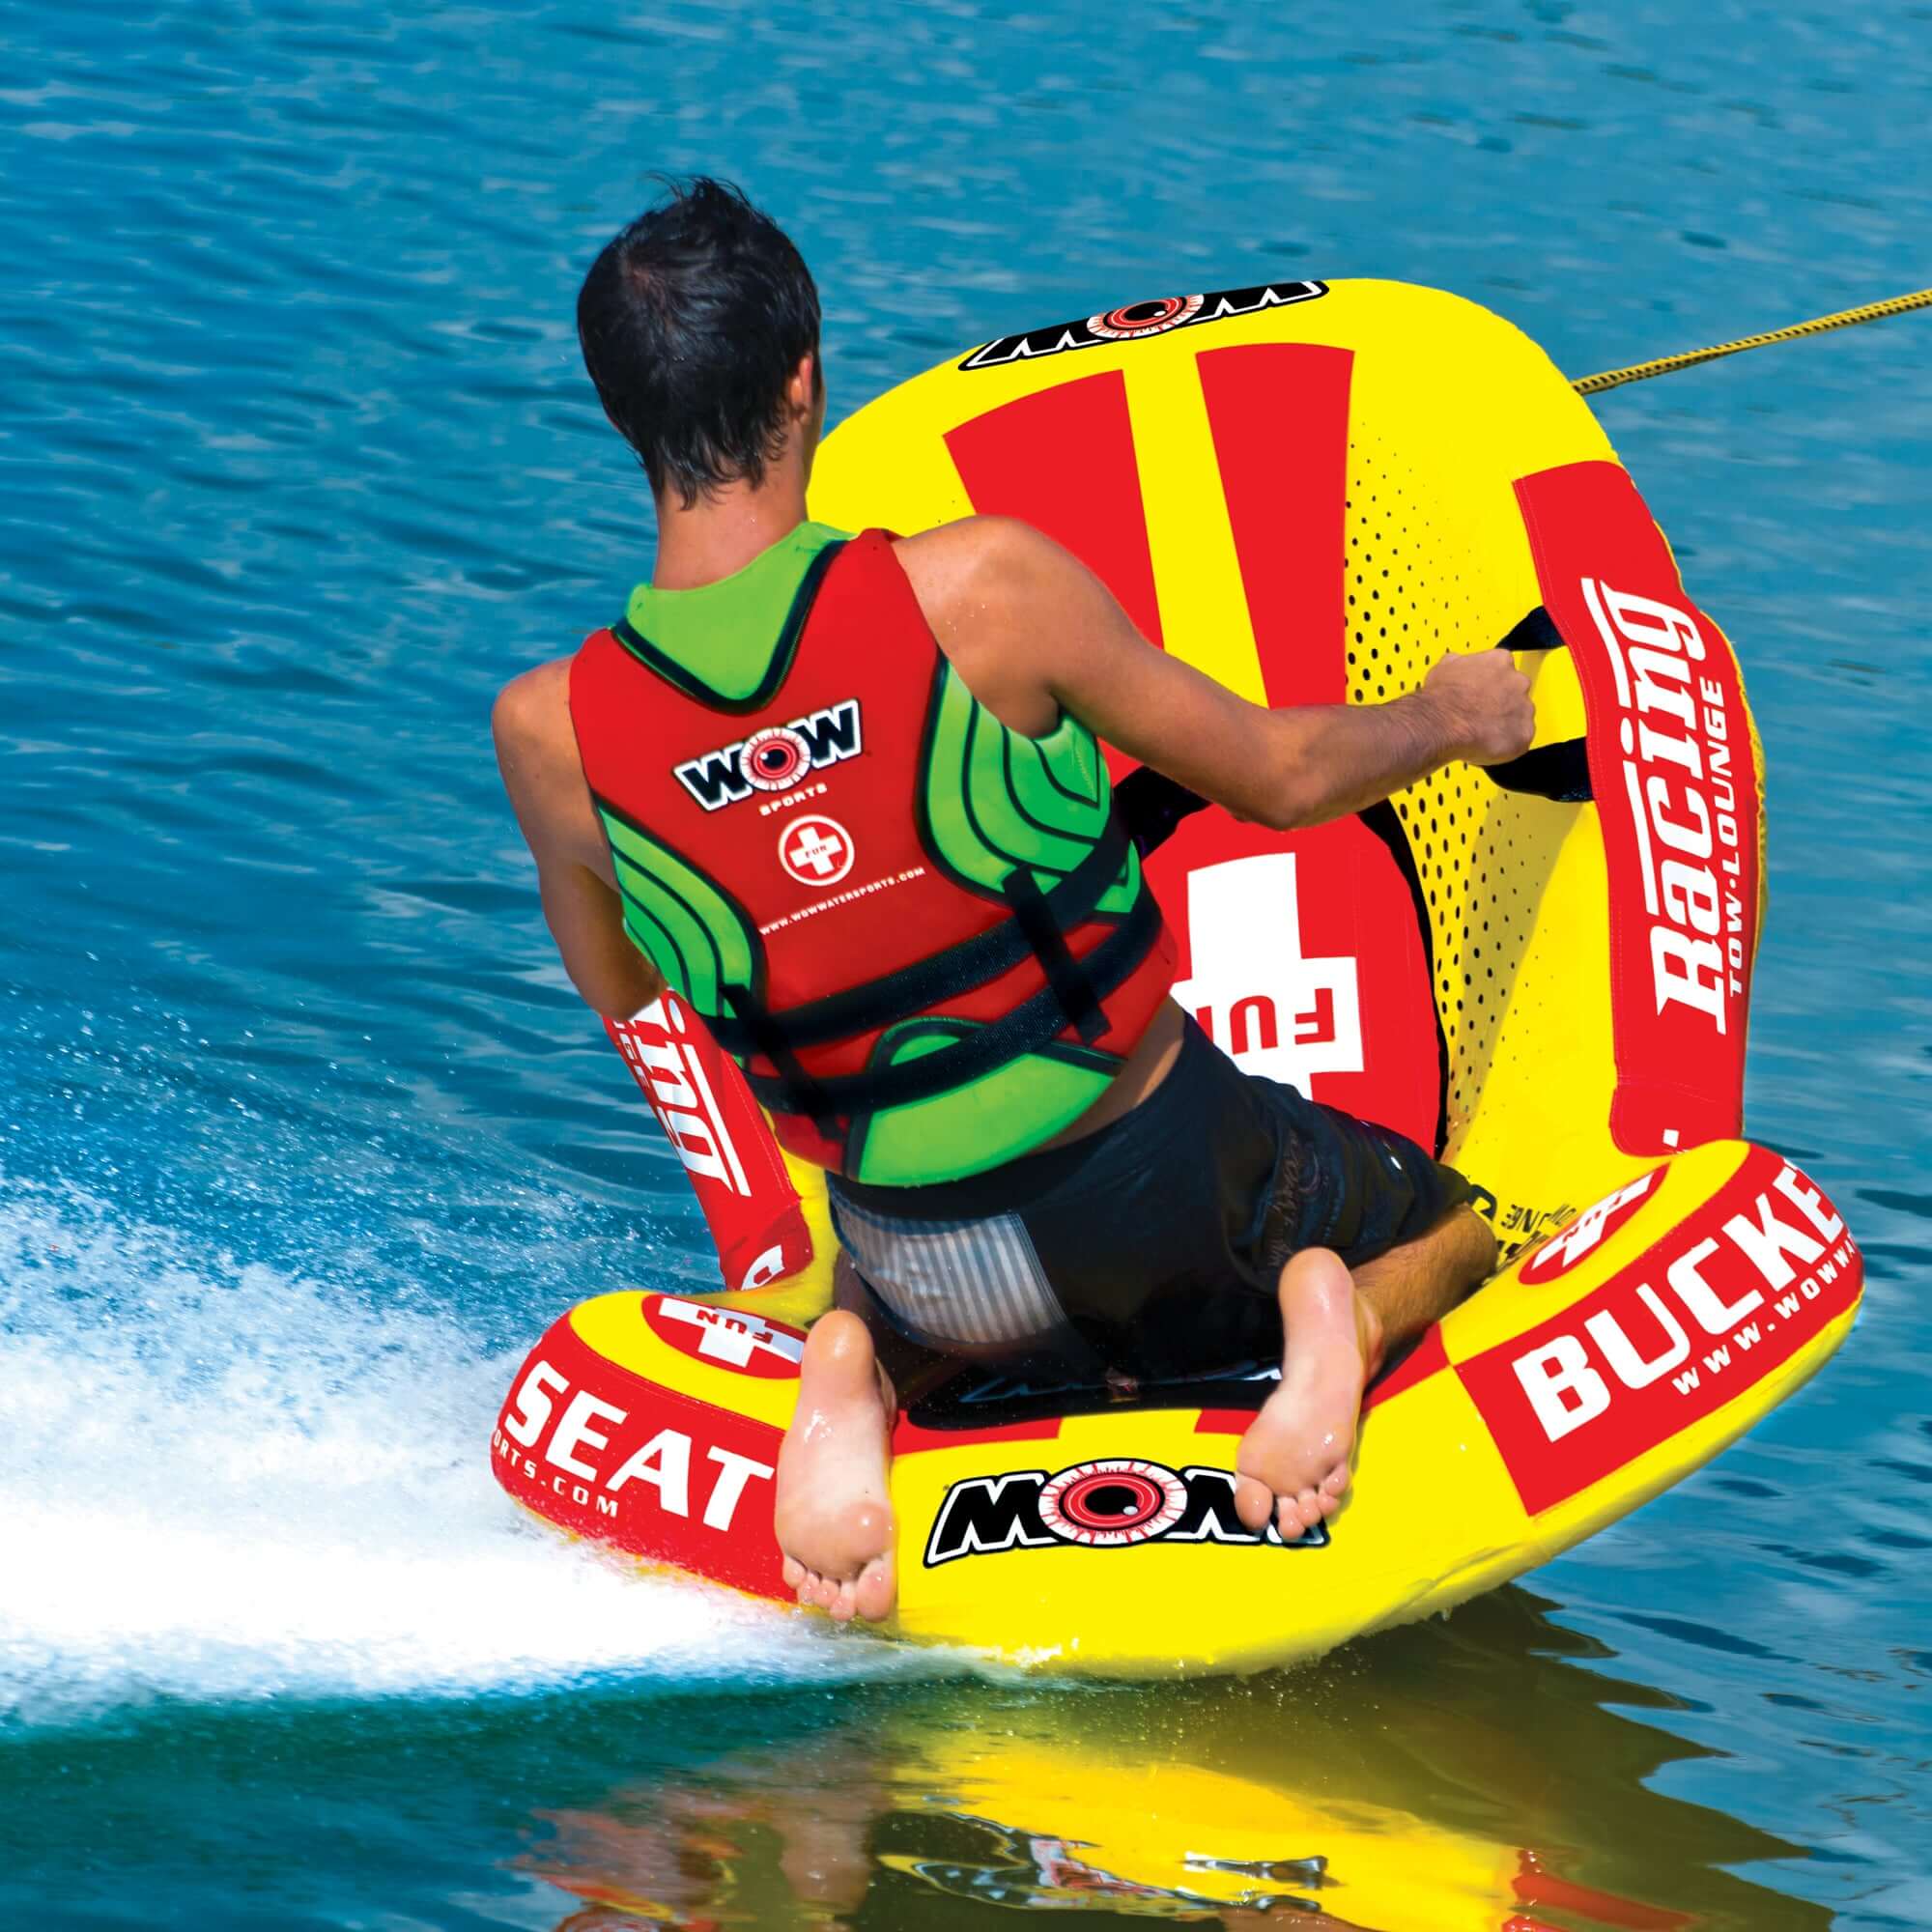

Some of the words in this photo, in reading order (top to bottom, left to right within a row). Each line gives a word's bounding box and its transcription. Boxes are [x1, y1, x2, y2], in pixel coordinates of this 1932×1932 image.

[673, 697, 863, 811] WOW
[758, 782, 828, 816] SPORTS
[805, 843, 827, 859] FUN
[1581, 578, 1727, 1035] Racing
[759, 866, 926, 936] WWW.WOWWATERSPORTS.COM
[696, 1309, 774, 1345] FUN
[1511, 1157, 1844, 1443] BUCKE
[503, 1359, 776, 1532] SEAT
